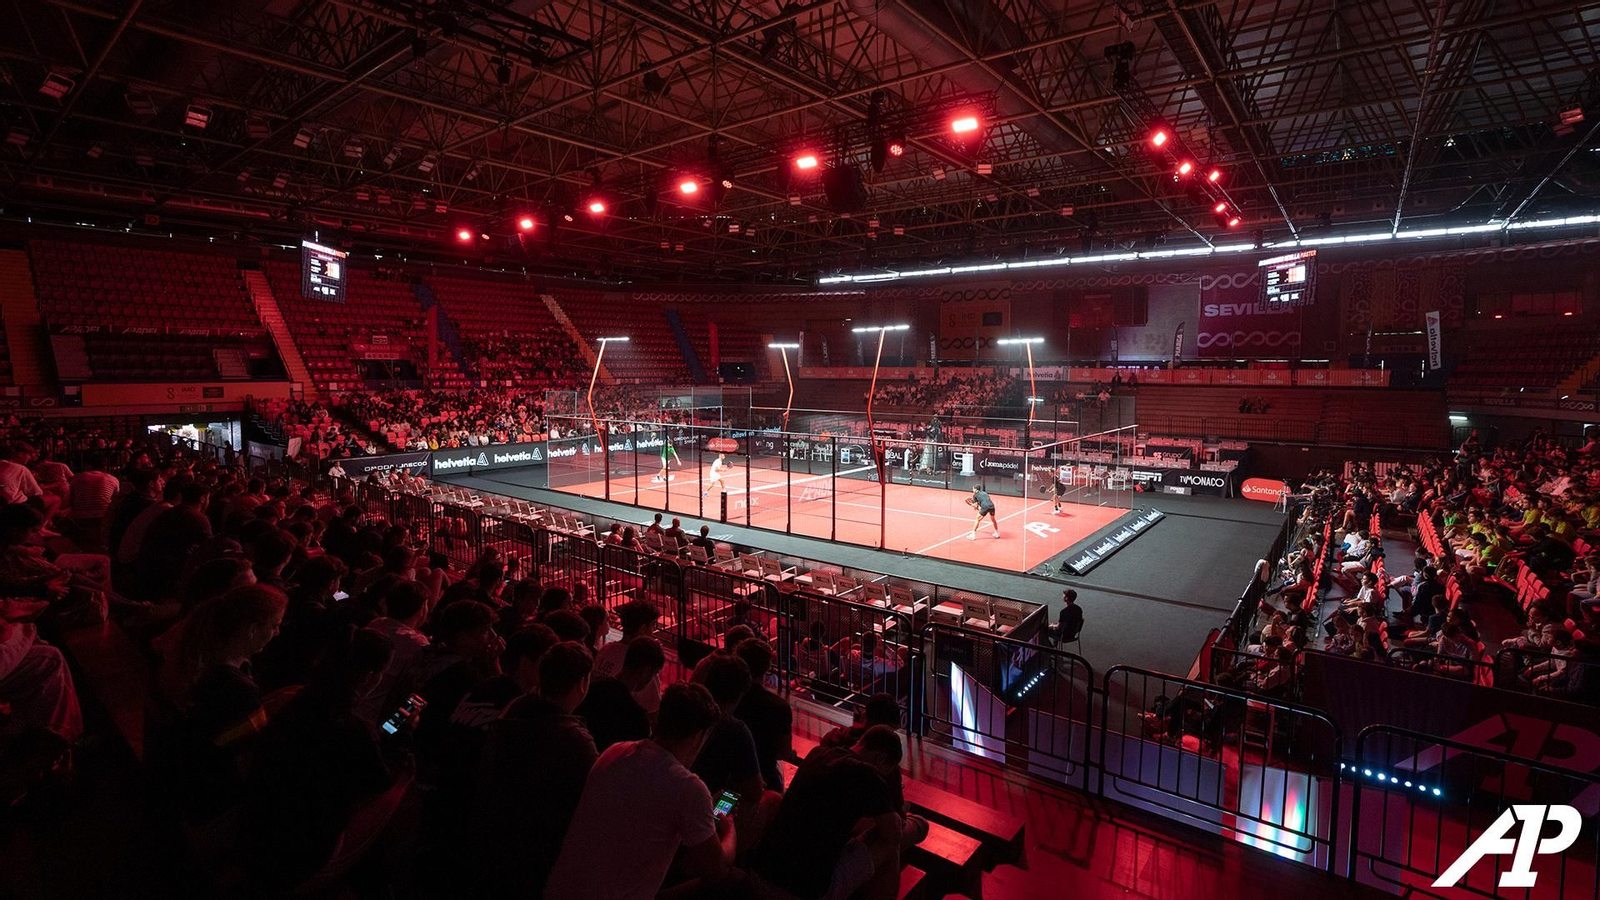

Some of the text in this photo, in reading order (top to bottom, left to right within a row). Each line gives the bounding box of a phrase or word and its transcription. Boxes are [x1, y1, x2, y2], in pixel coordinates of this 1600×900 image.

[594, 441, 624, 453] hevetia
[435, 457, 477, 469] helvetia
[494, 451, 531, 464] helvetia
[1031, 464, 1055, 473] helvet
[1132, 471, 1163, 483] ESPN
[1251, 485, 1284, 496] Santand
